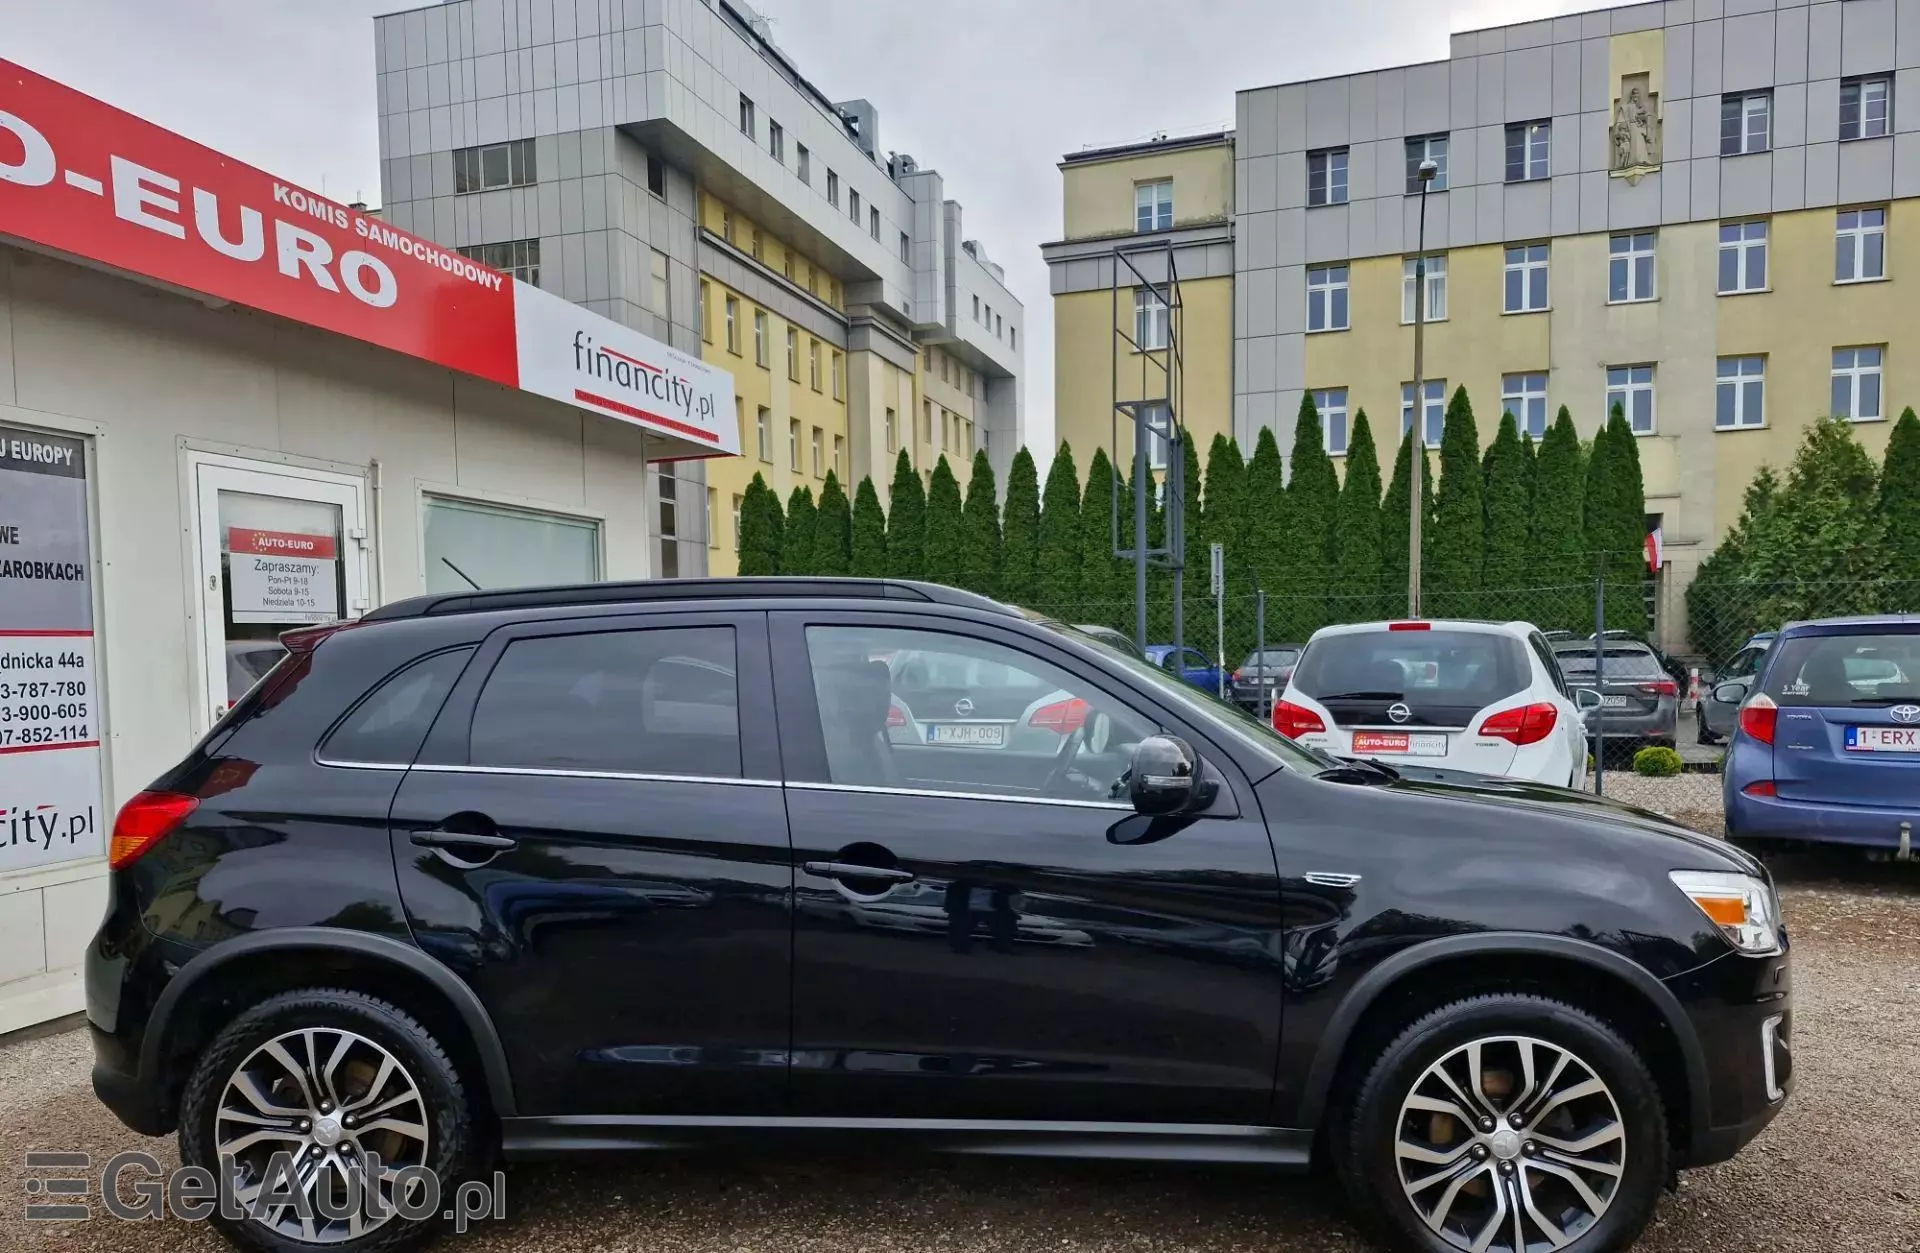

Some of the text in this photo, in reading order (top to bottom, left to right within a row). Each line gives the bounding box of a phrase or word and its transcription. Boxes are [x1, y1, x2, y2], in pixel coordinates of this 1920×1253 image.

[273, 182, 502, 292] KOMIS SAMOCHODOWY
[573, 330, 715, 421] financity.pl
[11, 440, 73, 466] EUROPY
[258, 537, 314, 551] AUTO-EURO
[0, 559, 84, 581] AROBKACH
[268, 586, 293, 596] Sobota
[262, 597, 295, 607] Niedziela
[0, 651, 85, 670] dnicka 44a
[0, 680, 87, 699] 3-787-780
[1, 702, 88, 722] 3-900-605
[1357, 738, 1407, 747] AUTO-EURO
